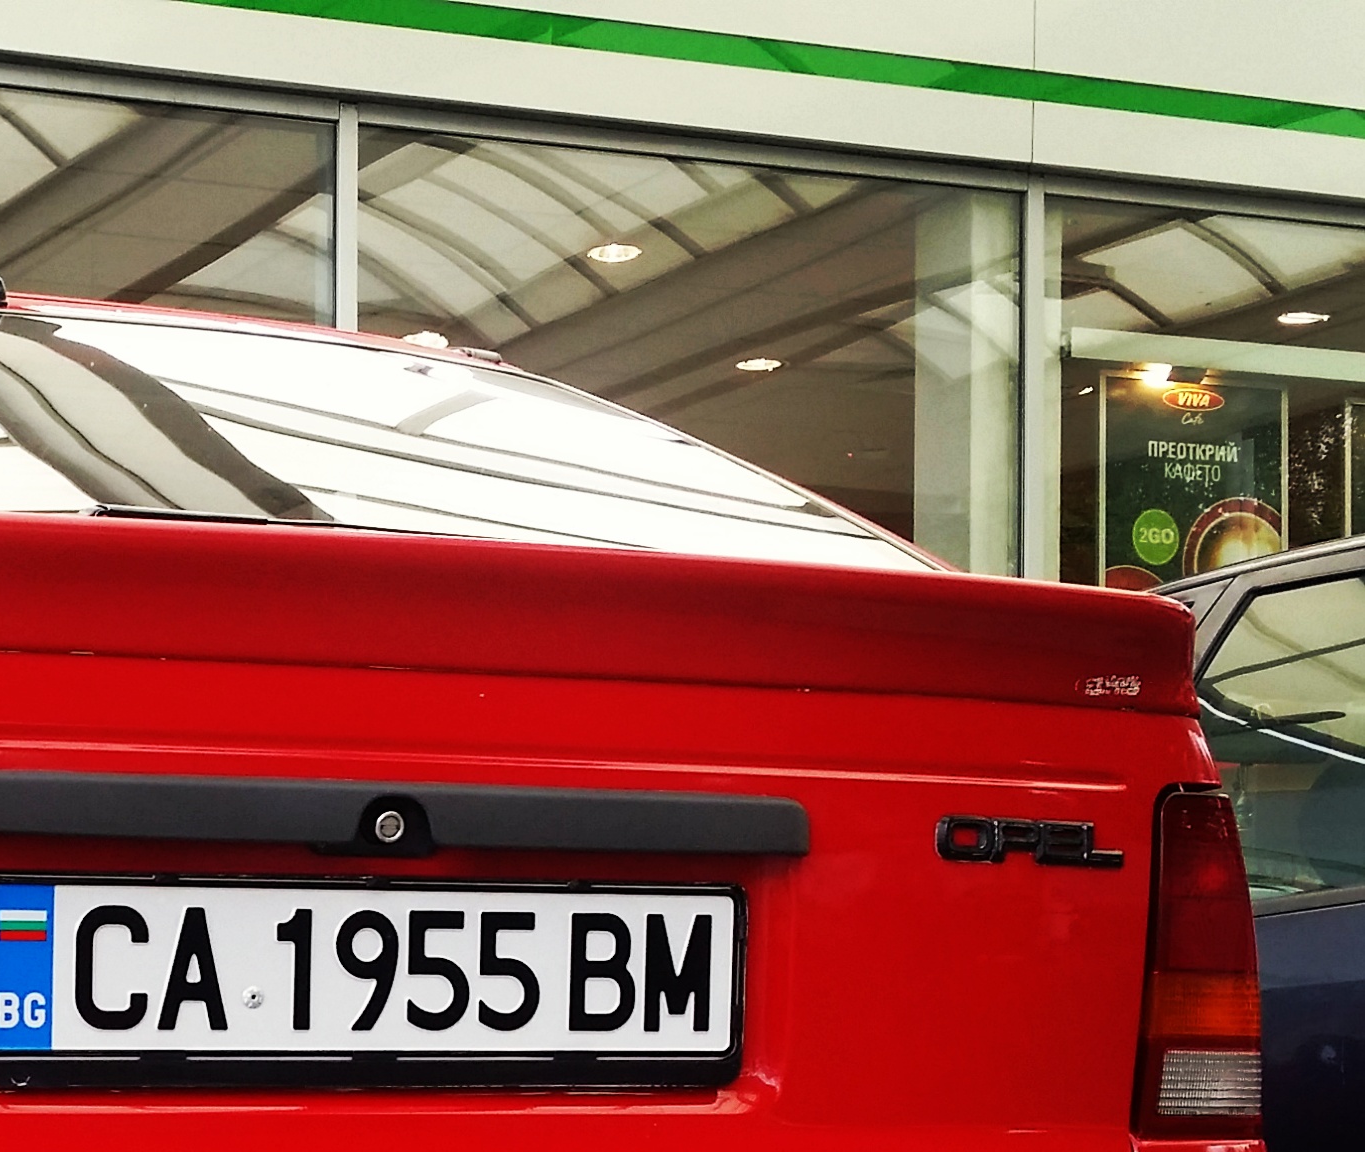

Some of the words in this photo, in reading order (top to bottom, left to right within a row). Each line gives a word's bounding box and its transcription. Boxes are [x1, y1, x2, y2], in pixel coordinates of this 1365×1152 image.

[1178, 392, 1210, 407] VIVA
[1148, 440, 1239, 463] ПРЕОТКРИЙ
[1164, 462, 1222, 483] КАФЕТО
[1138, 527, 1175, 544] 2GO
[936, 814, 1125, 869] OPEL
[75, 905, 228, 1031] CA
[275, 908, 541, 1032] 1955
[567, 911, 713, 1034] BM
